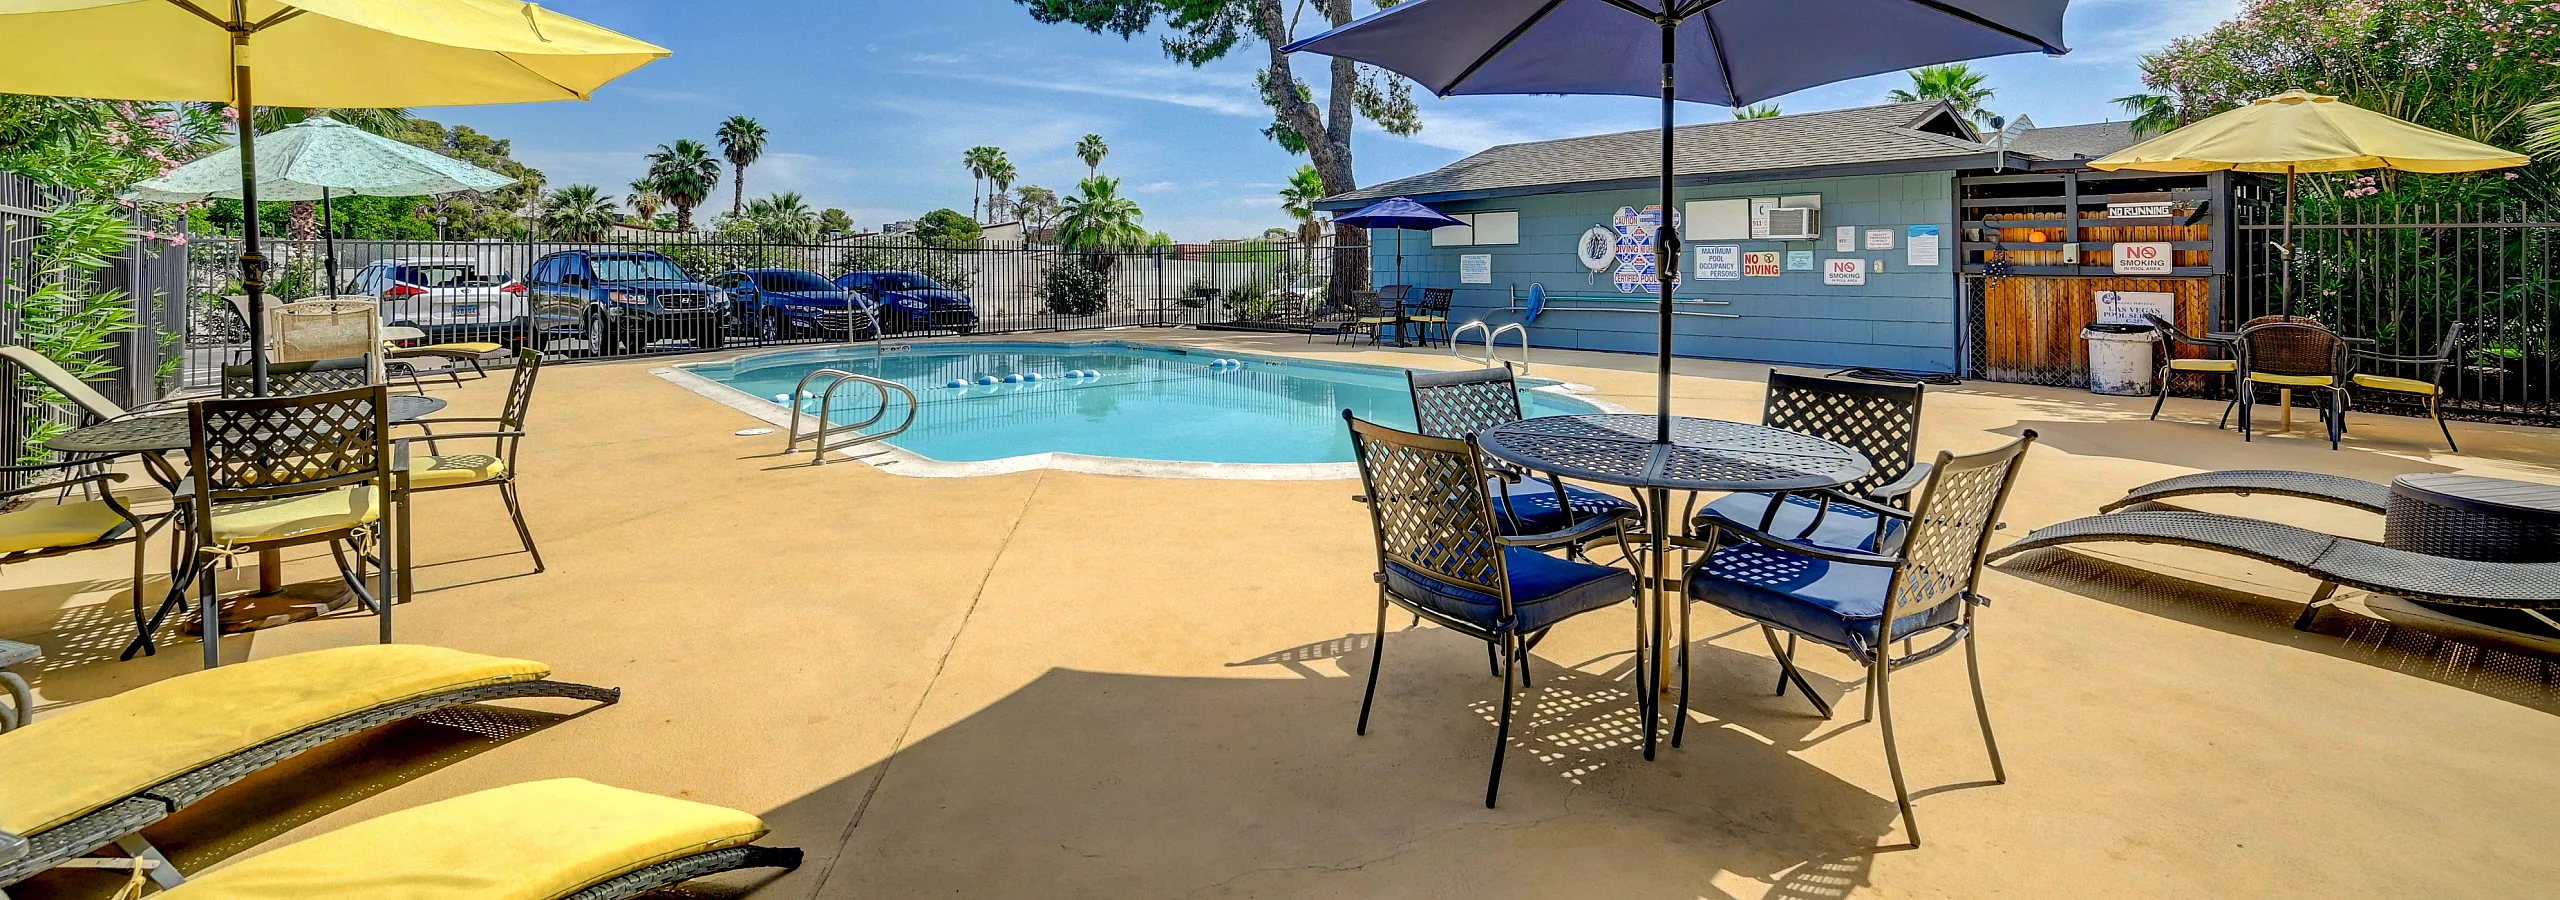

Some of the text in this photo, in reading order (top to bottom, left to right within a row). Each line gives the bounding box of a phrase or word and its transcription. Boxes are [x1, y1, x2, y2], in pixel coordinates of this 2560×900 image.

[2109, 206, 2170, 216] NO RUNNING
[1614, 216, 1638, 225] CAUTION
[1622, 236, 1633, 245] NO
[1615, 245, 1639, 253] DIVING
[2126, 246, 2157, 259] NO
[1744, 254, 1759, 264] NO
[2119, 259, 2165, 267] SMOKING
[1699, 262, 1735, 270] OCCUPANCY
[1744, 264, 1779, 275] DIVING
[1834, 262, 1855, 272] NO
[1614, 274, 1639, 283] CERTIFIED
[1640, 274, 1658, 283] POOL
[1710, 270, 1738, 278] PERSONS
[2103, 311, 2127, 319] POOL
